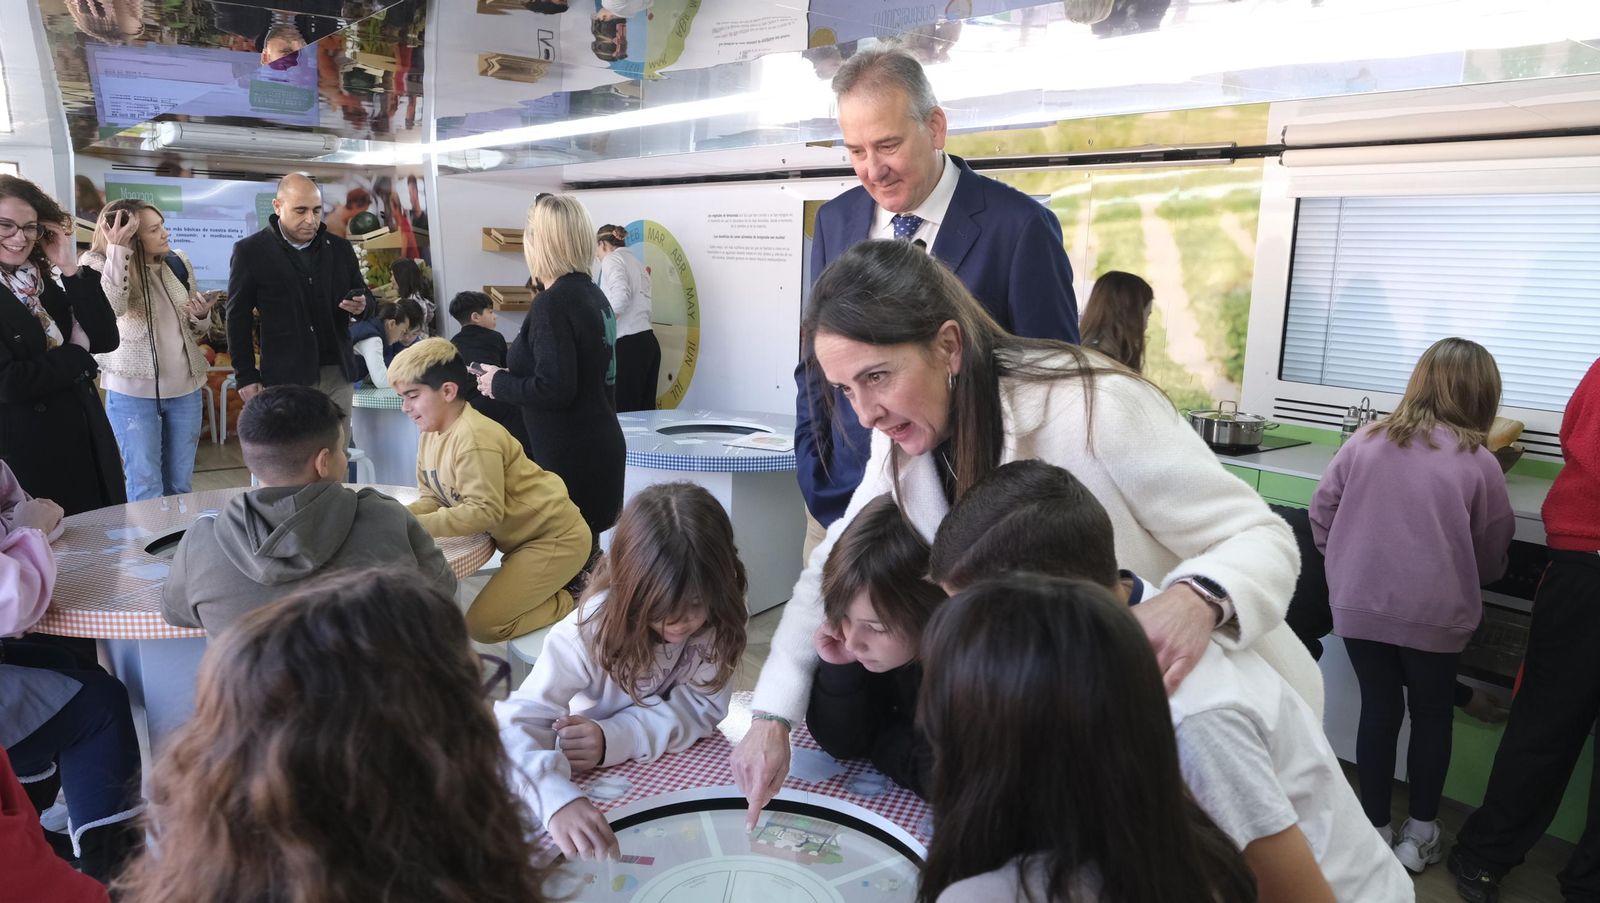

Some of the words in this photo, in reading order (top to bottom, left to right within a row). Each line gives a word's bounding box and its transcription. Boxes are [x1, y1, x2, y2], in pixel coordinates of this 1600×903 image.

[647, 226, 666, 247] MAR
[671, 248, 687, 275] ABR
[685, 287, 696, 321] MAY
